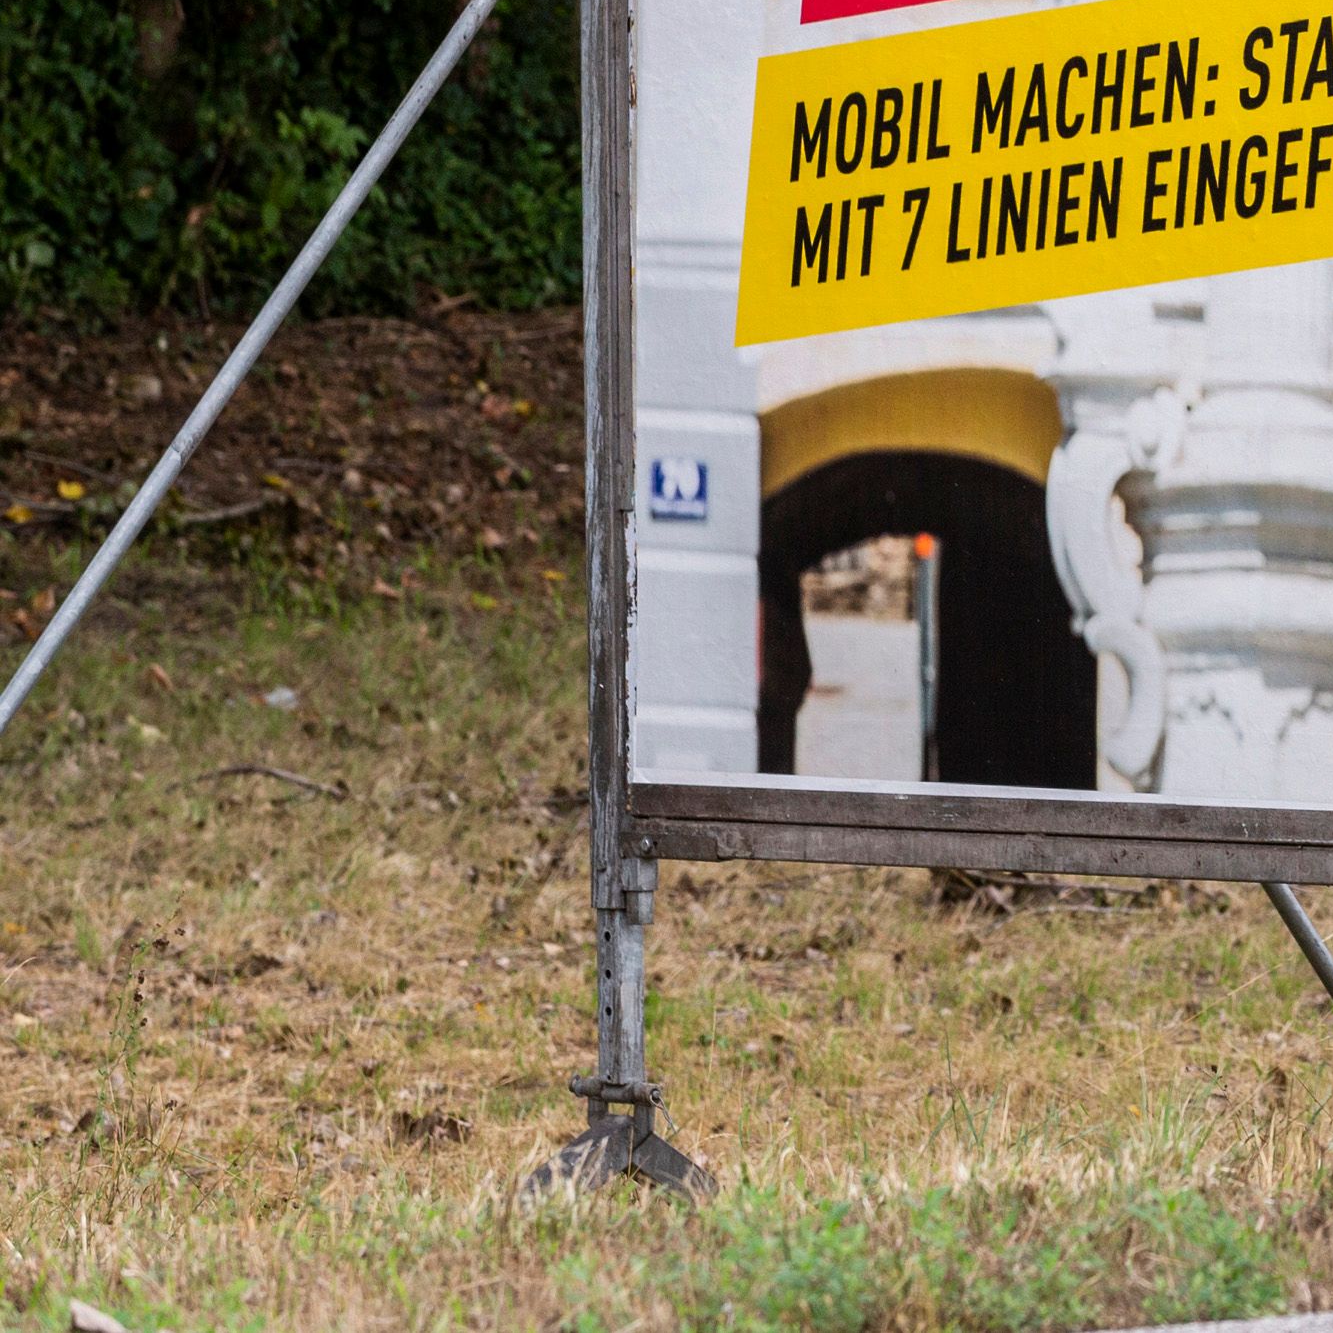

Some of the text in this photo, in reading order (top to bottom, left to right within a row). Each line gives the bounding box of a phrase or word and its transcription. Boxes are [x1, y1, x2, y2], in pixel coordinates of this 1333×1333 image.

[789, 79, 951, 183] MOBIL
[971, 37, 1220, 154] MACHEN:
[791, 194, 886, 288] MIT
[901, 186, 931, 271] 7
[946, 156, 1124, 264] LINIEN
